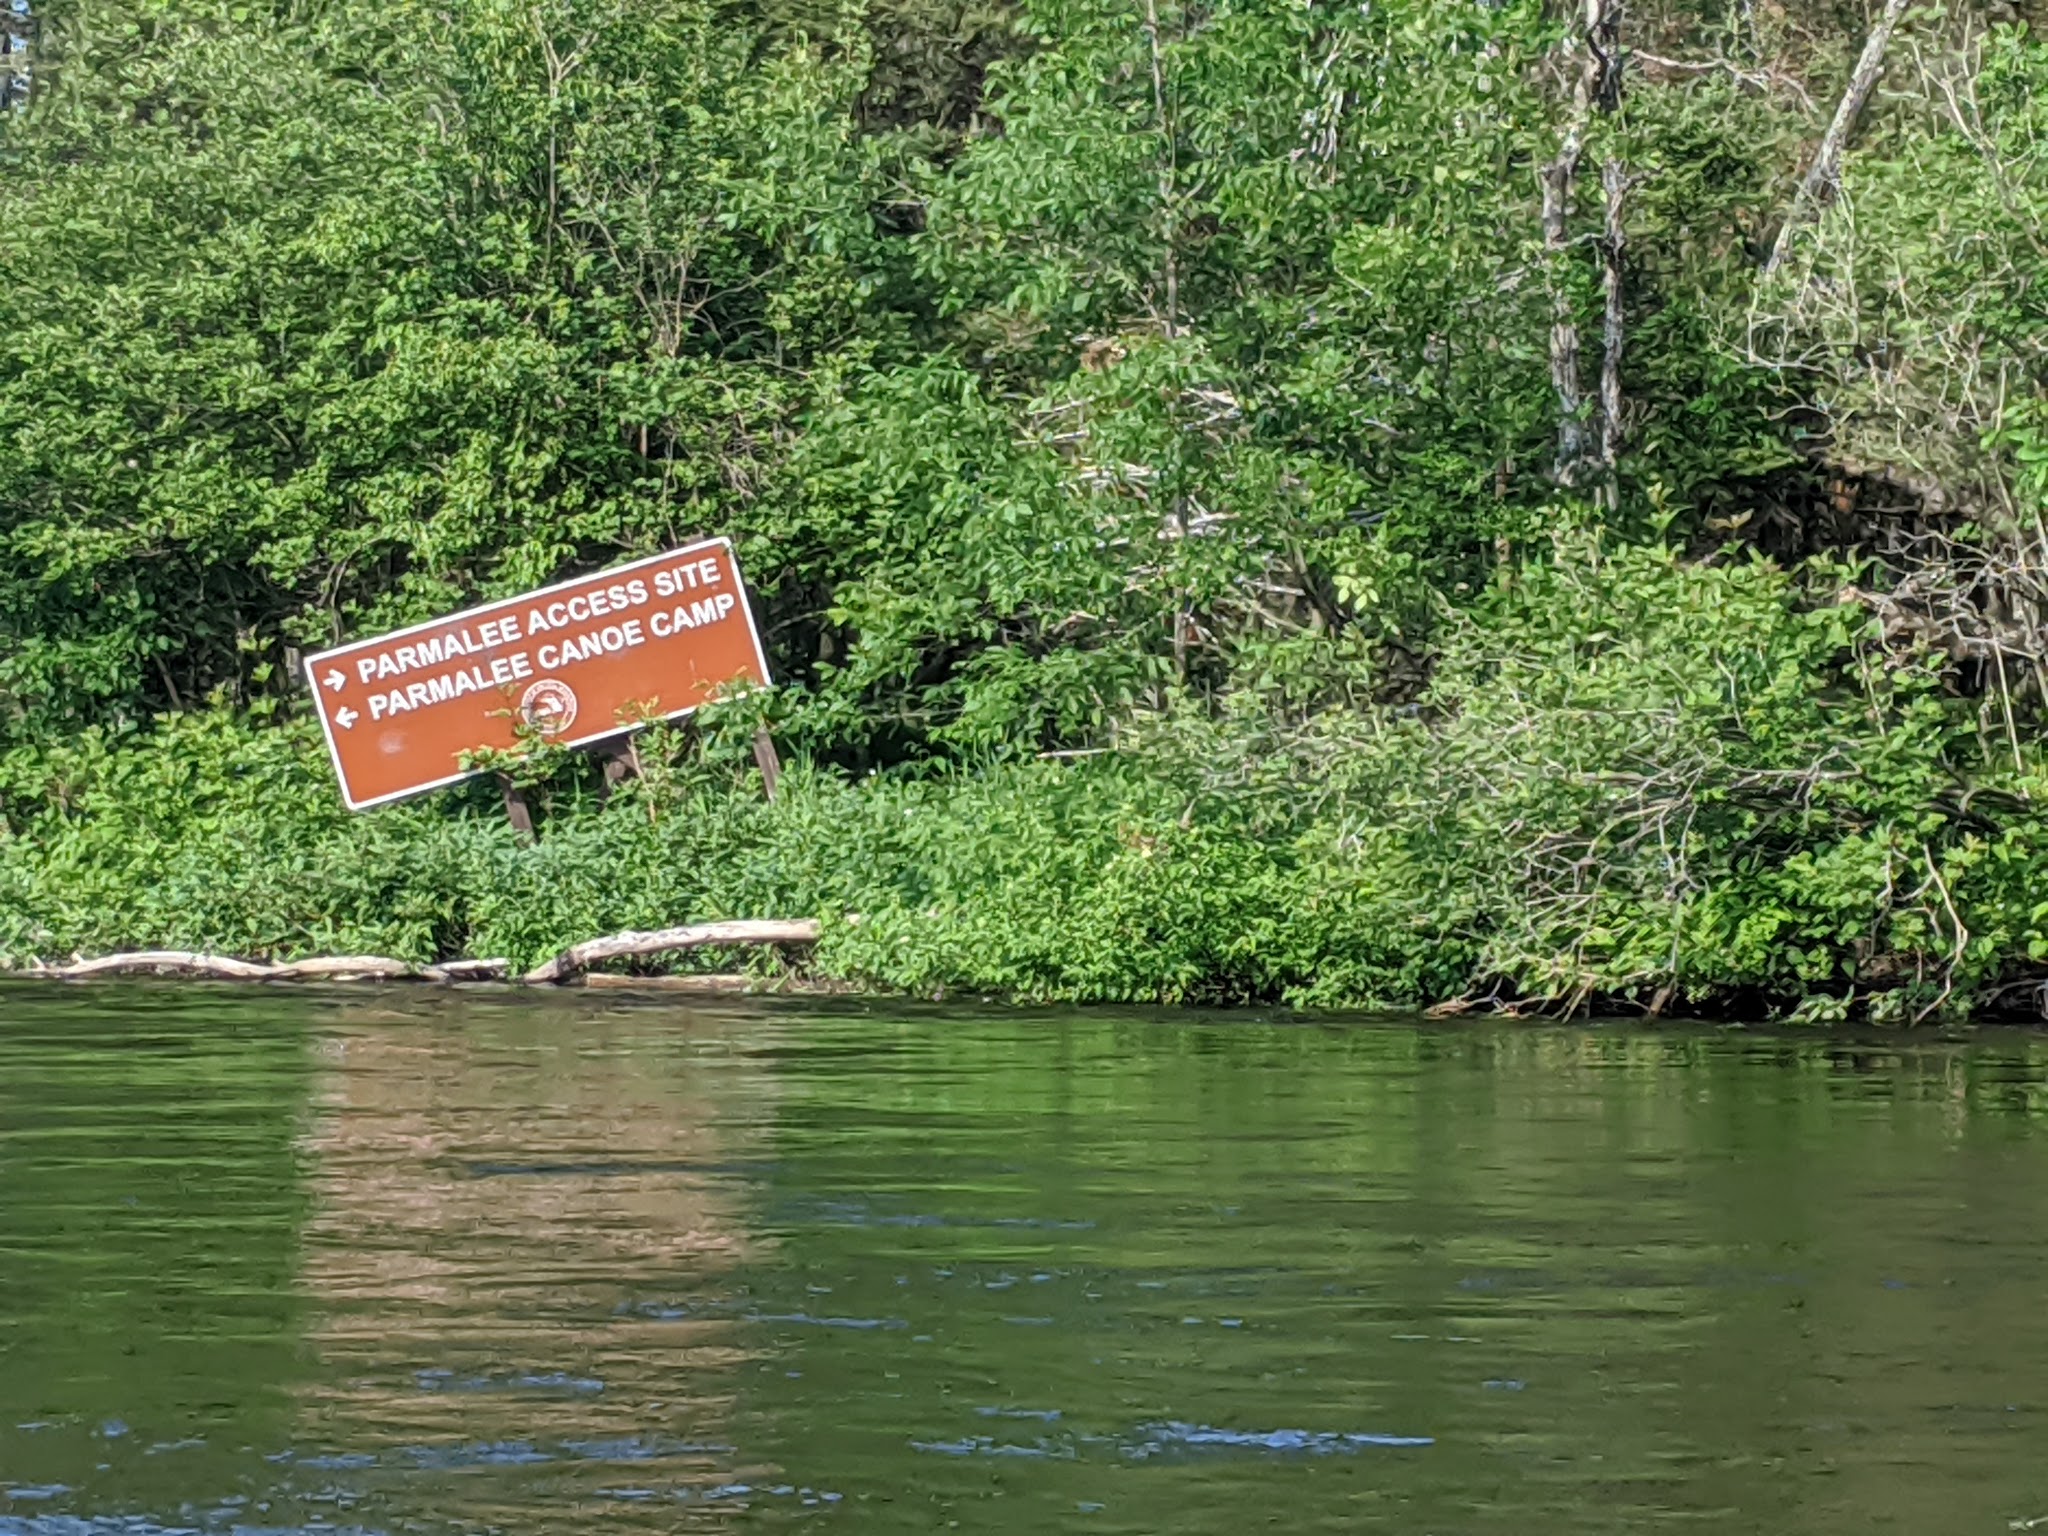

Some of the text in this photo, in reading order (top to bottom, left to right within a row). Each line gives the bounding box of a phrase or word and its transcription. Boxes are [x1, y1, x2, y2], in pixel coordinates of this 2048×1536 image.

[357, 557, 721, 683] PARMALEE ACCESS SITE
[367, 652, 533, 719] PARMALEE
[538, 619, 646, 670] CANOE
[650, 594, 735, 638] CAMP
